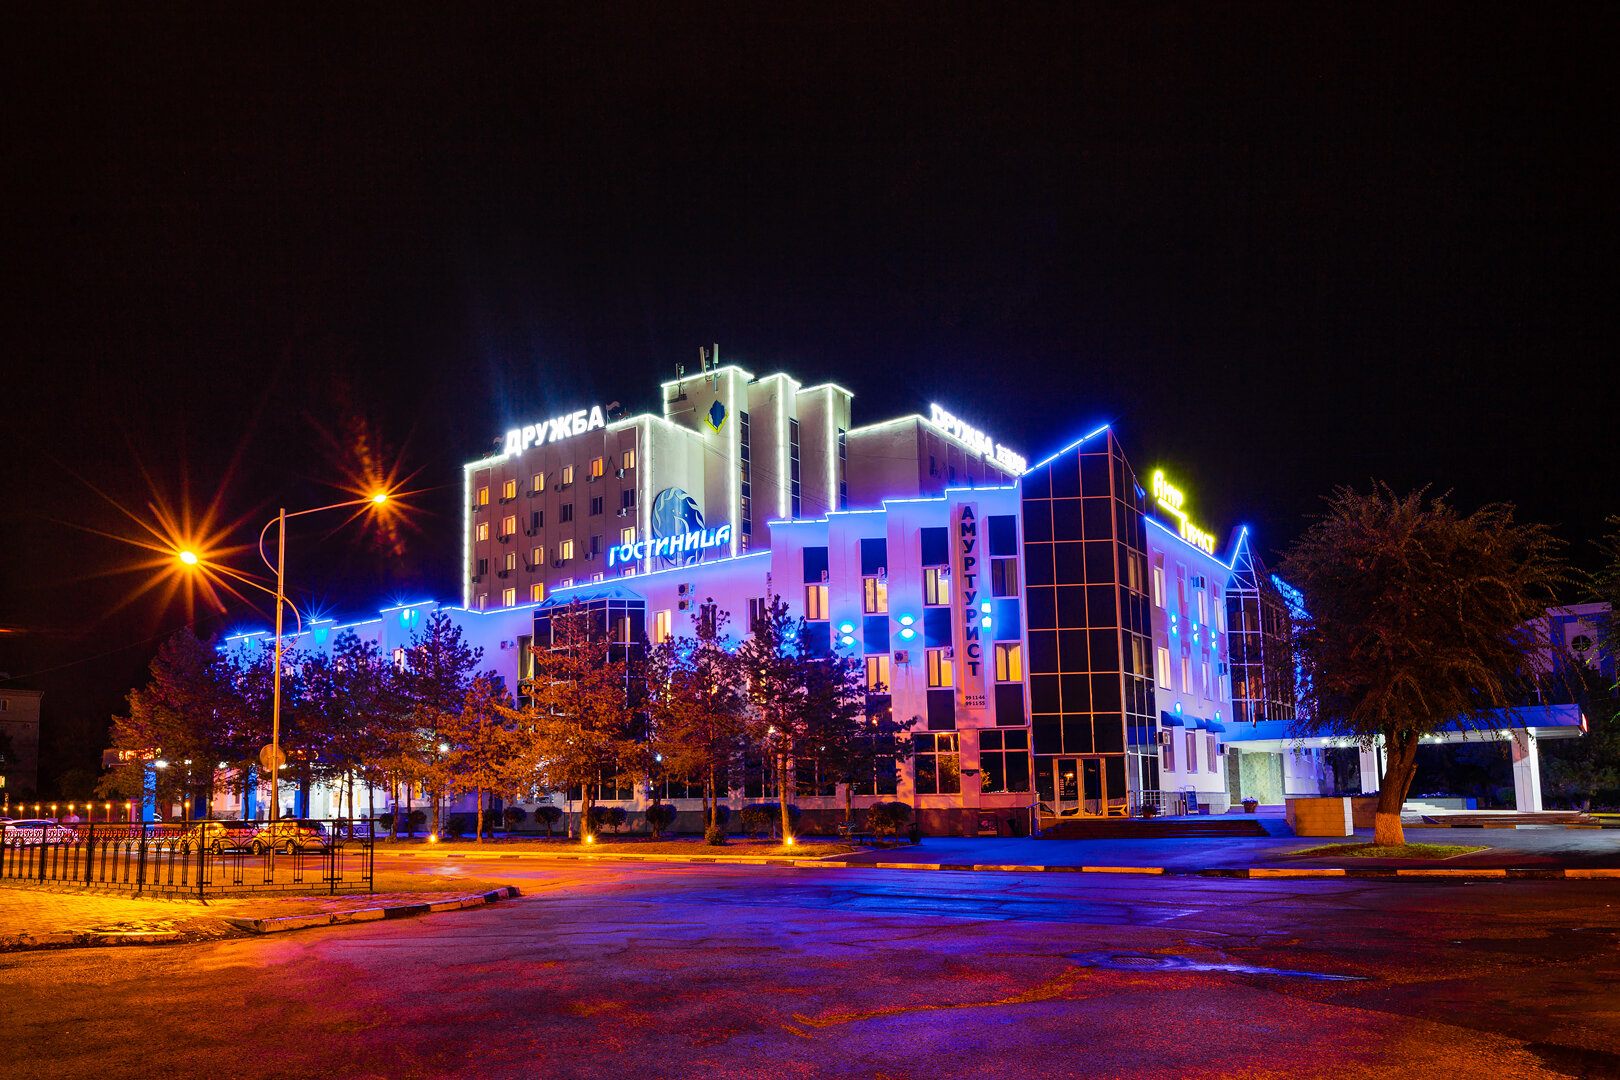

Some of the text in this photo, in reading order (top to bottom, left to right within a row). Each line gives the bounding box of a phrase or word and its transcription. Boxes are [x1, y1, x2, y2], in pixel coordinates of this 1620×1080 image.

[503, 405, 605, 458] ДРУЖБА
[930, 403, 995, 459] ДРУЖБА
[608, 524, 731, 567] ГОСТИНИЦА
[961, 505, 980, 677] АМУРТУРИСТ
